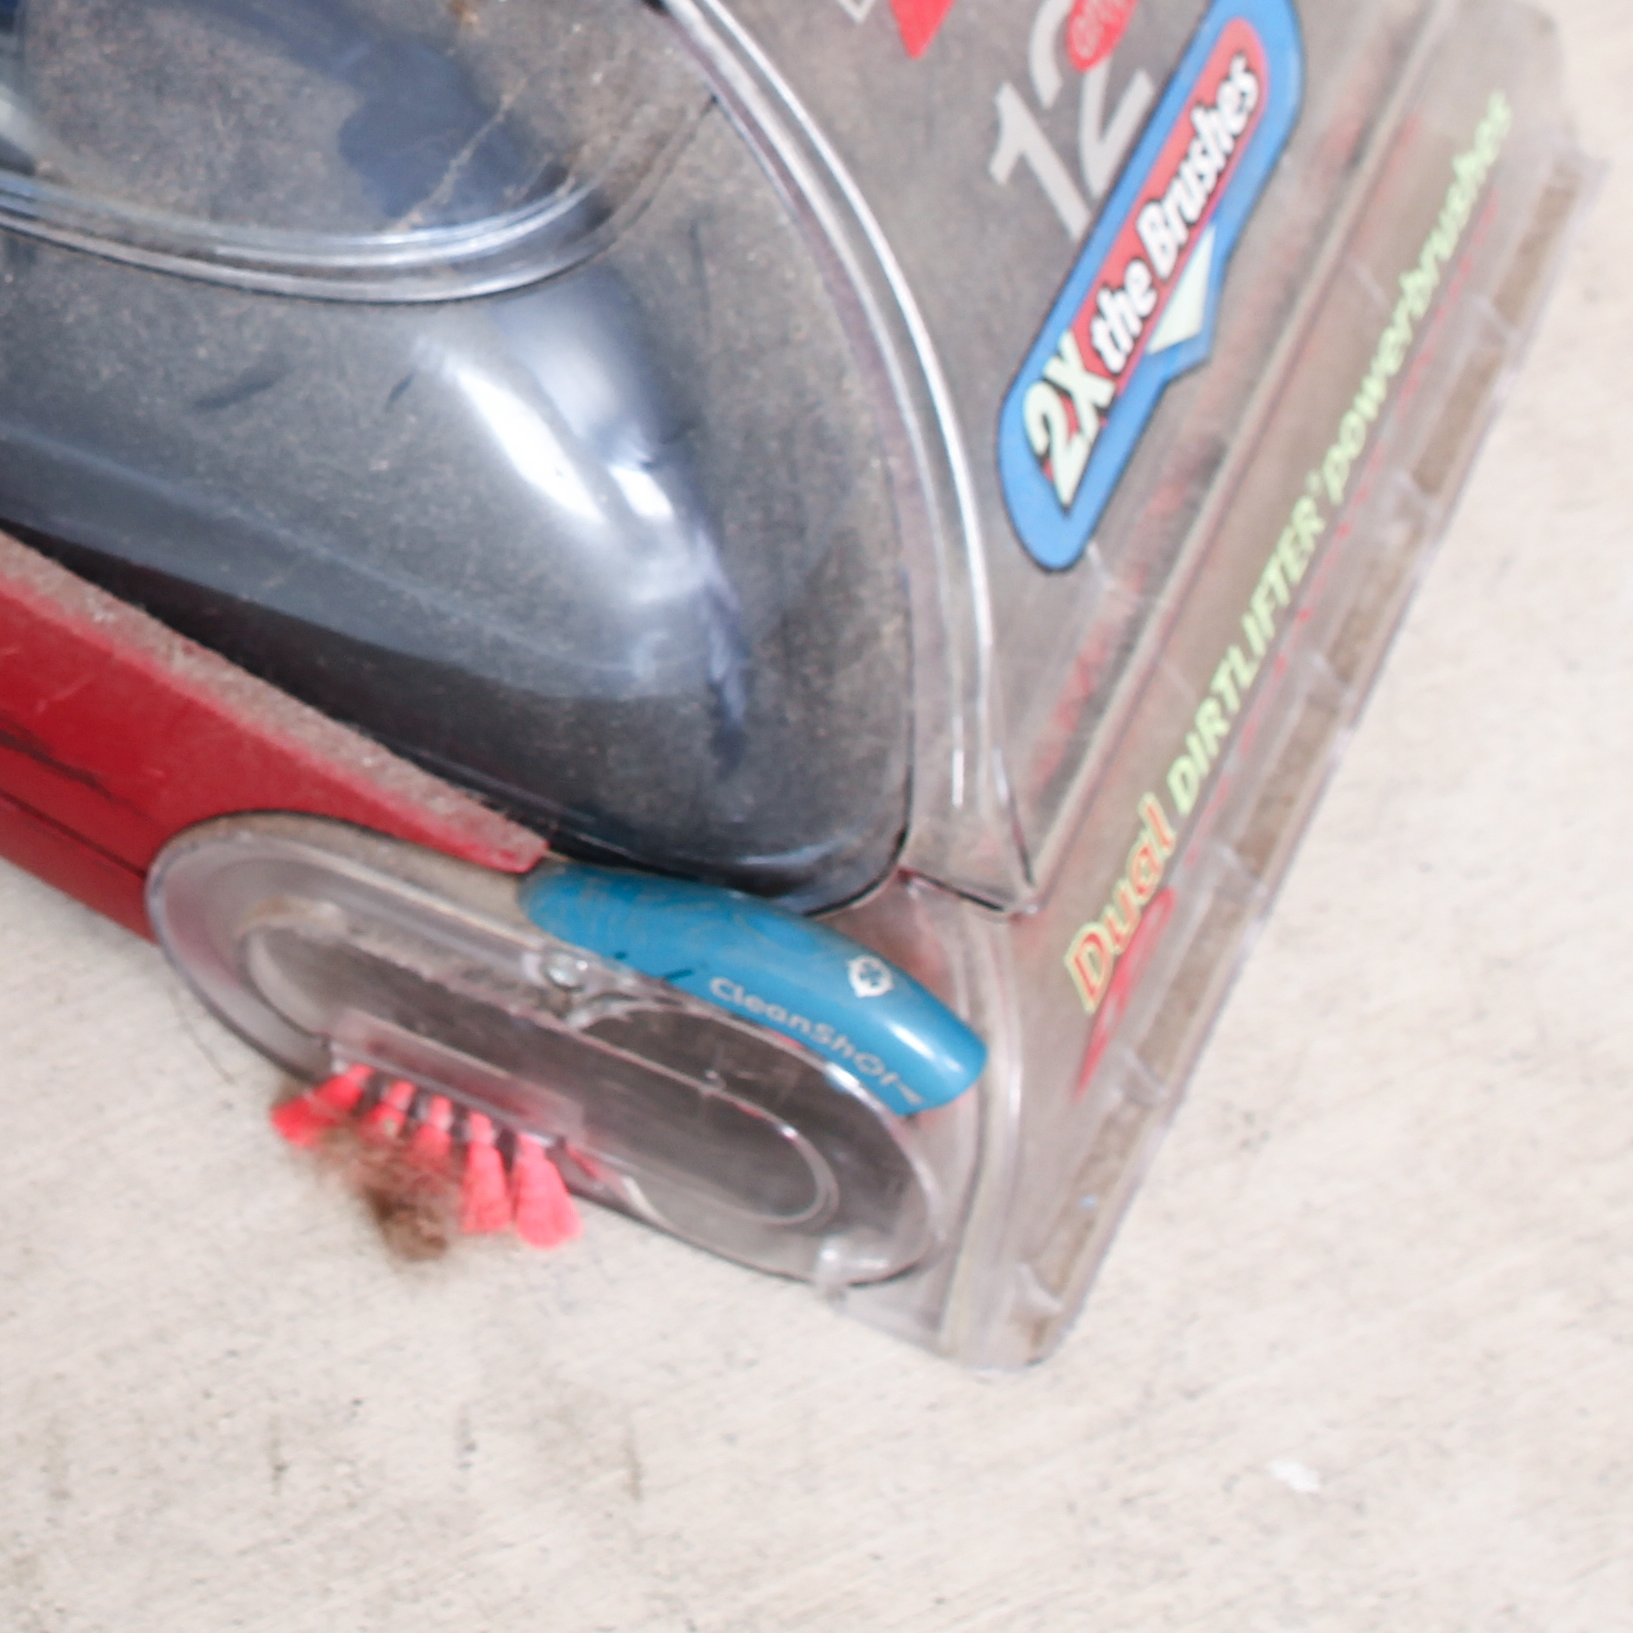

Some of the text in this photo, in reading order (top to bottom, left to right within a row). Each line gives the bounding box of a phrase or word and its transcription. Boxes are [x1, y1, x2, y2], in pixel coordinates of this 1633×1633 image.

[1020, 56, 1260, 509] 2X the Brushes
[1064, 791, 1177, 1015] Dual
